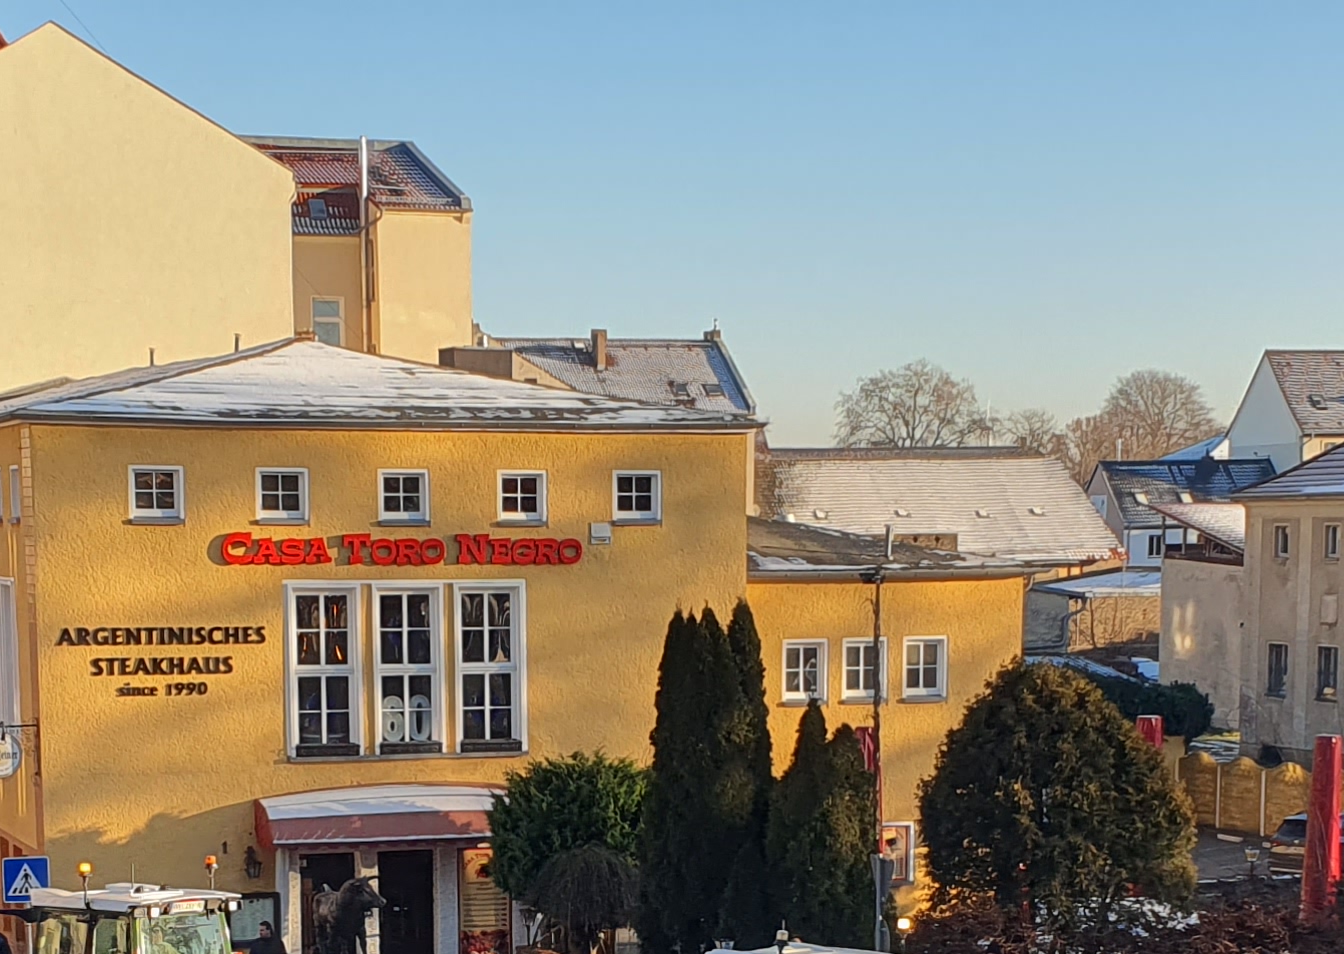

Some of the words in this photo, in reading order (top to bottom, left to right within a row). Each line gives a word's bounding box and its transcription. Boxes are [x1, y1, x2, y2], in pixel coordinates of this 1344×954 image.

[221, 532, 332, 565] CASA
[343, 533, 446, 566] TORO
[455, 533, 583, 566] NEGRO
[55, 626, 266, 646] ARGENTINISCHES
[90, 656, 233, 676] STEAKHAUS
[115, 682, 158, 697] since
[165, 682, 208, 696] 1990
